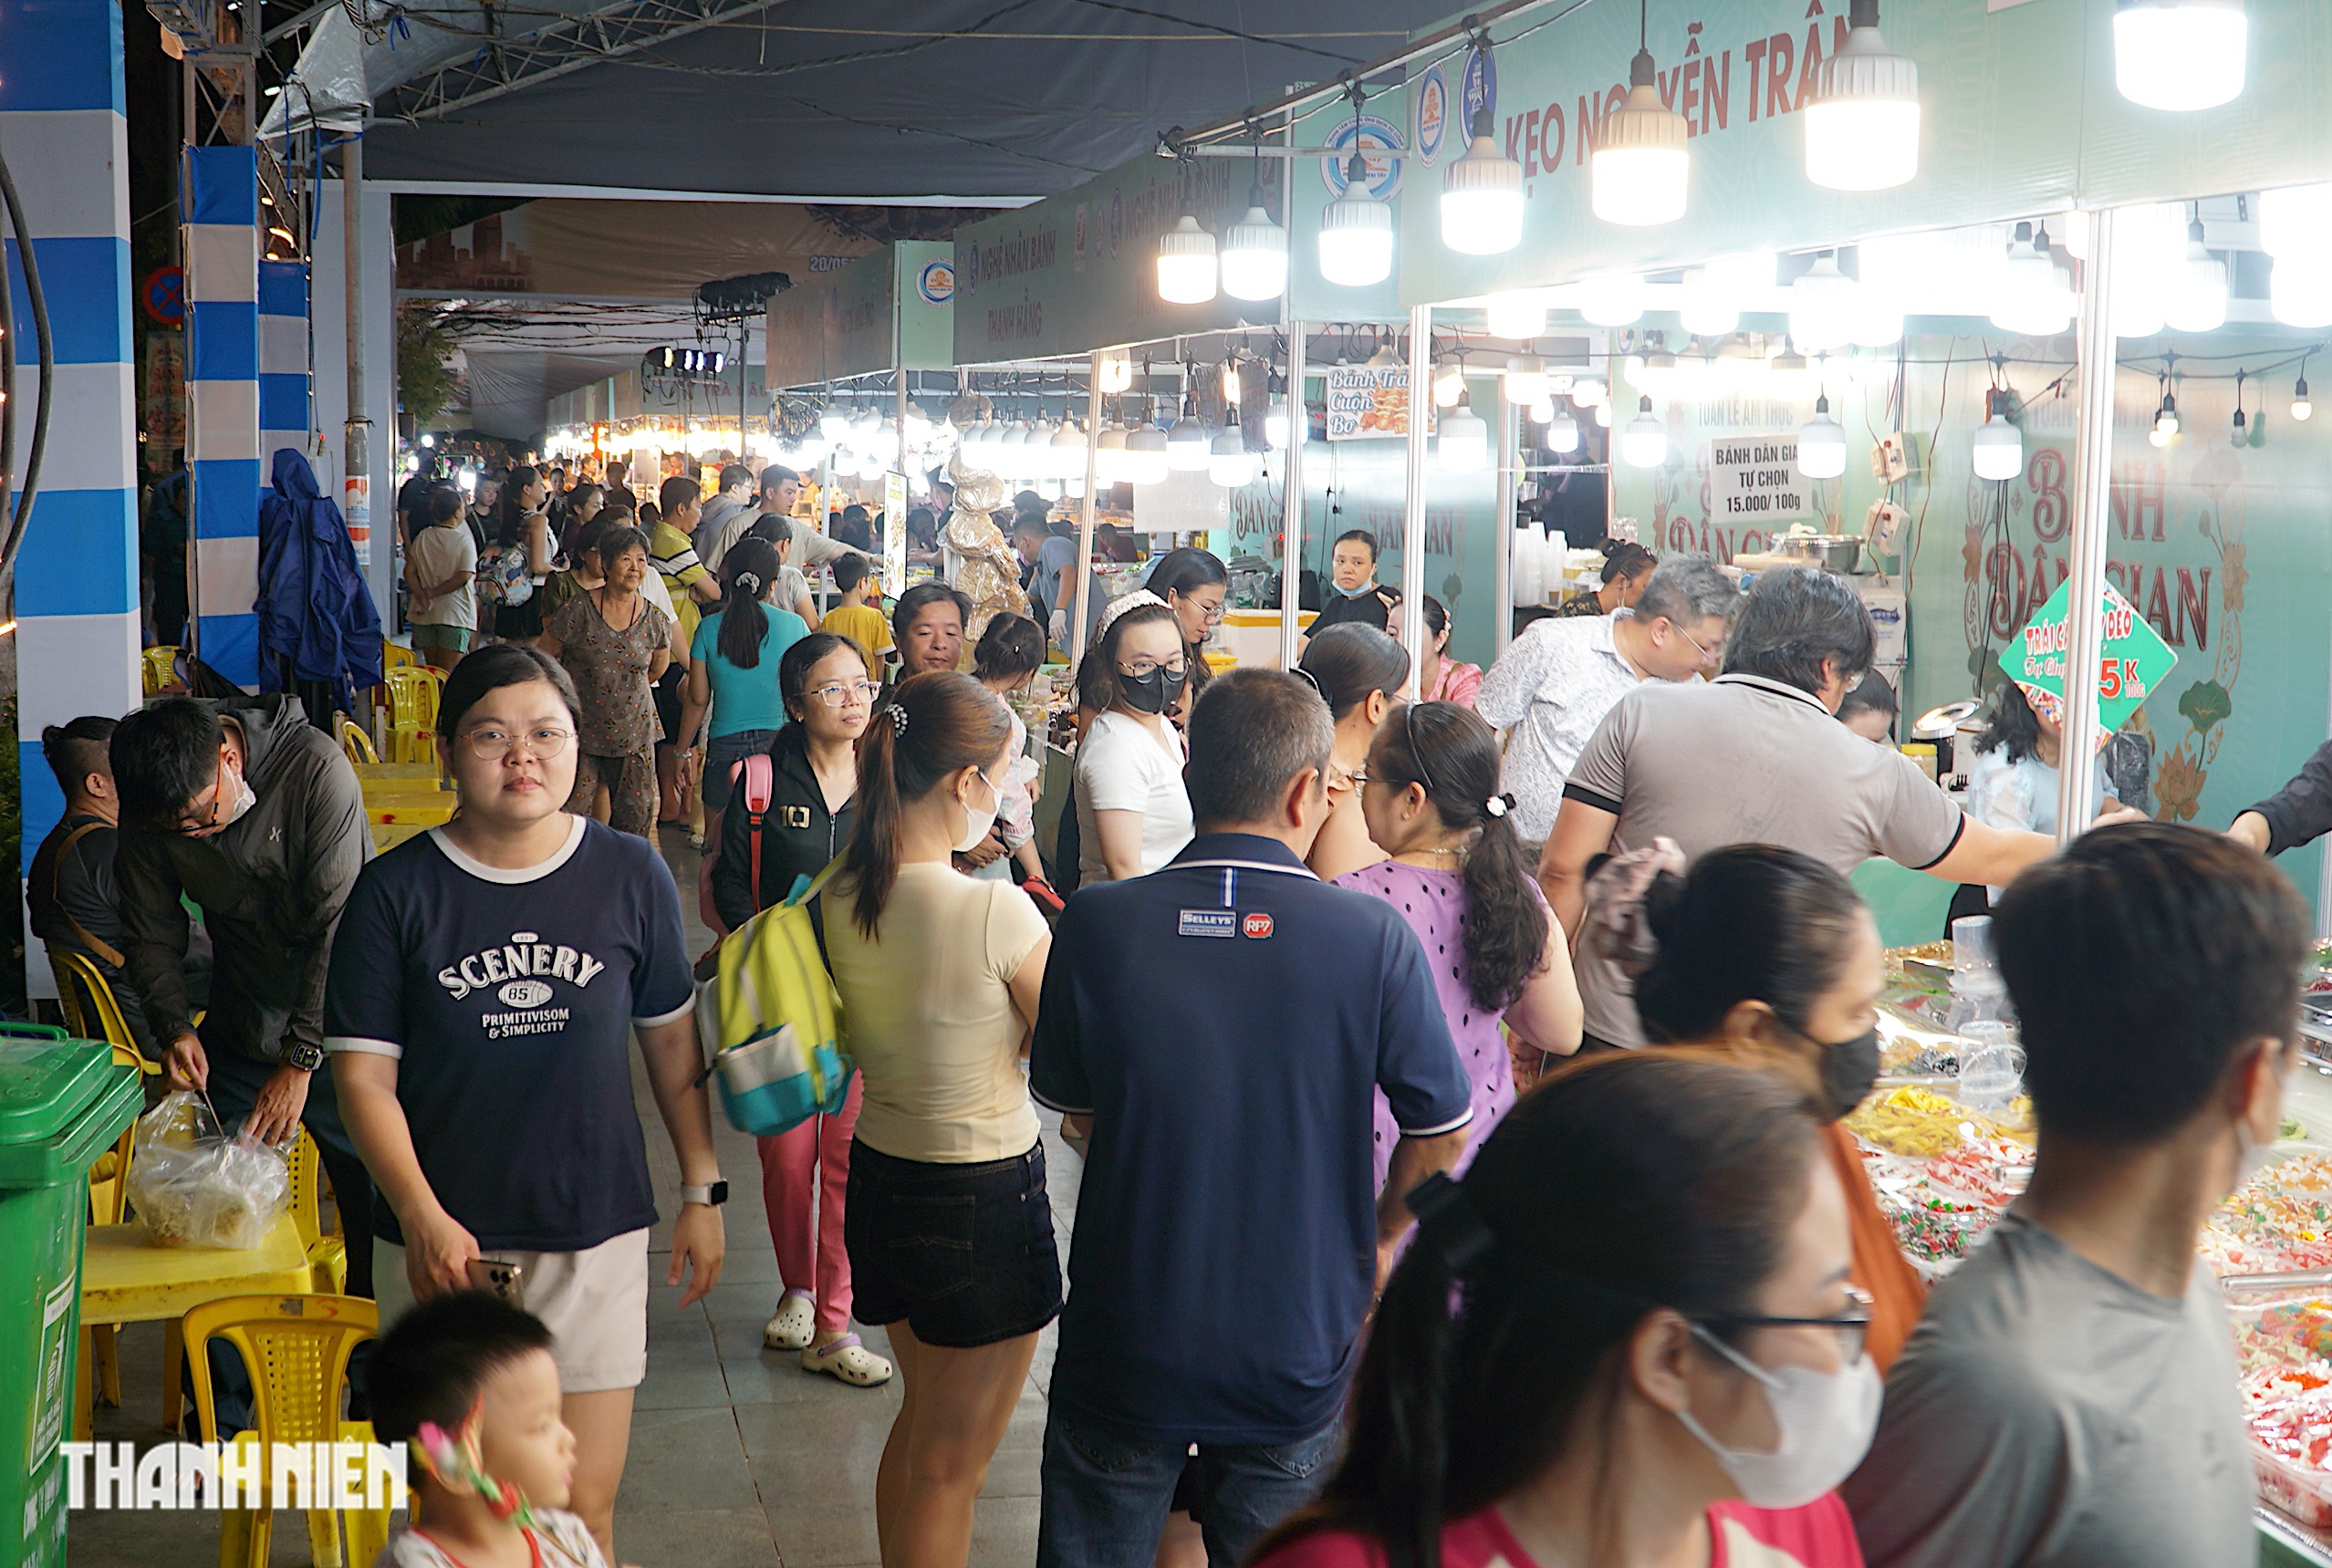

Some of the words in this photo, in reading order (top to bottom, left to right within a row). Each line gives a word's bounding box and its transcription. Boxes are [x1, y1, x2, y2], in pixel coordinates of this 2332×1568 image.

[1745, 0, 1851, 122] TRÂ
[1329, 369, 1377, 389] Bánh
[1379, 369, 1410, 389] Trá
[1329, 391, 1373, 415] Cuộn
[1329, 415, 1358, 435] Bơ
[1716, 444, 1750, 465] BÁNH
[1754, 443, 1778, 463] DÂN
[1782, 445, 1798, 461] GIA
[1739, 470, 1755, 492] TỰ
[1758, 469, 1788, 490] CHỌN
[1726, 494, 1772, 513] 15.000/
[1775, 493, 1801, 510] 100g
[2025, 617, 2055, 656] TRÁI
[779, 805, 810, 828] 10
[1183, 914, 1232, 925] SELLEYS
[1246, 919, 1271, 932] RP7
[438, 944, 606, 1001] SCENERY
[508, 987, 529, 1001] 85
[482, 1008, 569, 1028] PRIMITIVISOM
[488, 1027, 501, 1040] &
[501, 1021, 566, 1038] SIMPLICITY
